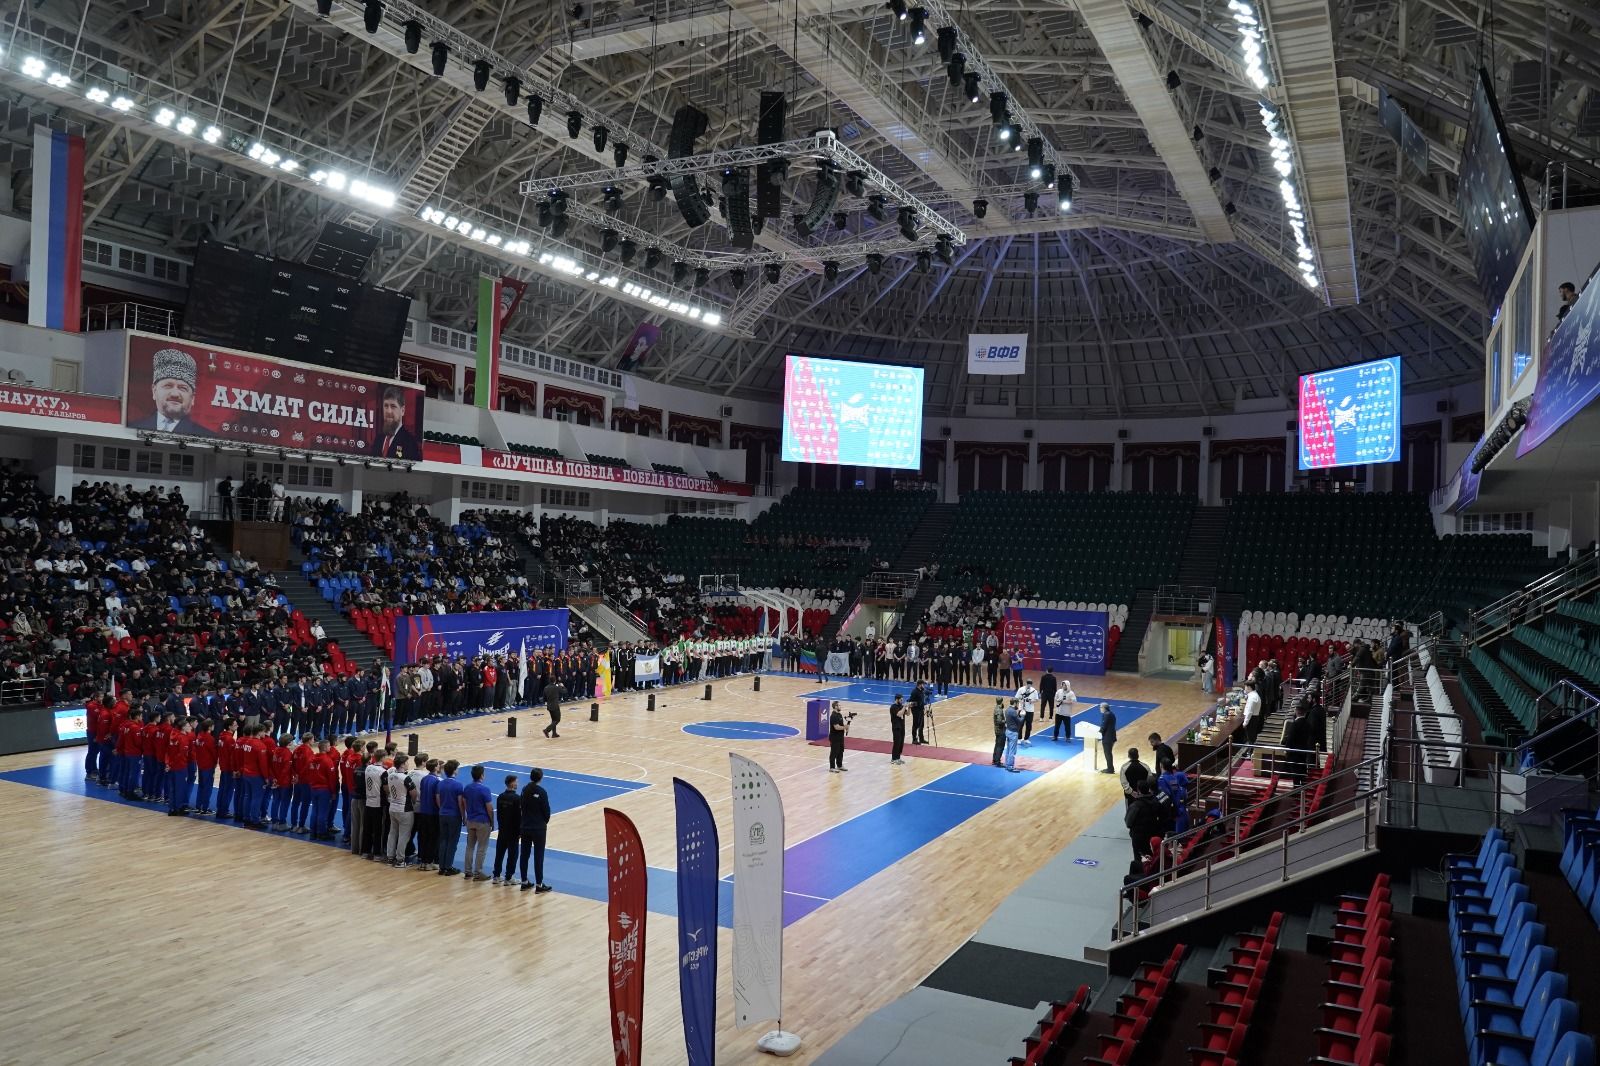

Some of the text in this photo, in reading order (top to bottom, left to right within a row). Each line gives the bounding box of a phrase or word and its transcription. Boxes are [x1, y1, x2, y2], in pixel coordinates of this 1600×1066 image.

[987, 345, 1020, 359] ВФВ
[0, 390, 70, 411] НАУКУ»
[211, 384, 375, 429] АХМАТ СИЛА!
[48, 410, 87, 420] КАДЫРОВ
[492, 454, 564, 474] «ЛУЧШАЯ
[565, 462, 615, 481] ПОБЕДА
[623, 469, 666, 487] ПОБЕДА
[667, 475, 675, 488] В
[675, 476, 719, 493] СПОРТЕ!»
